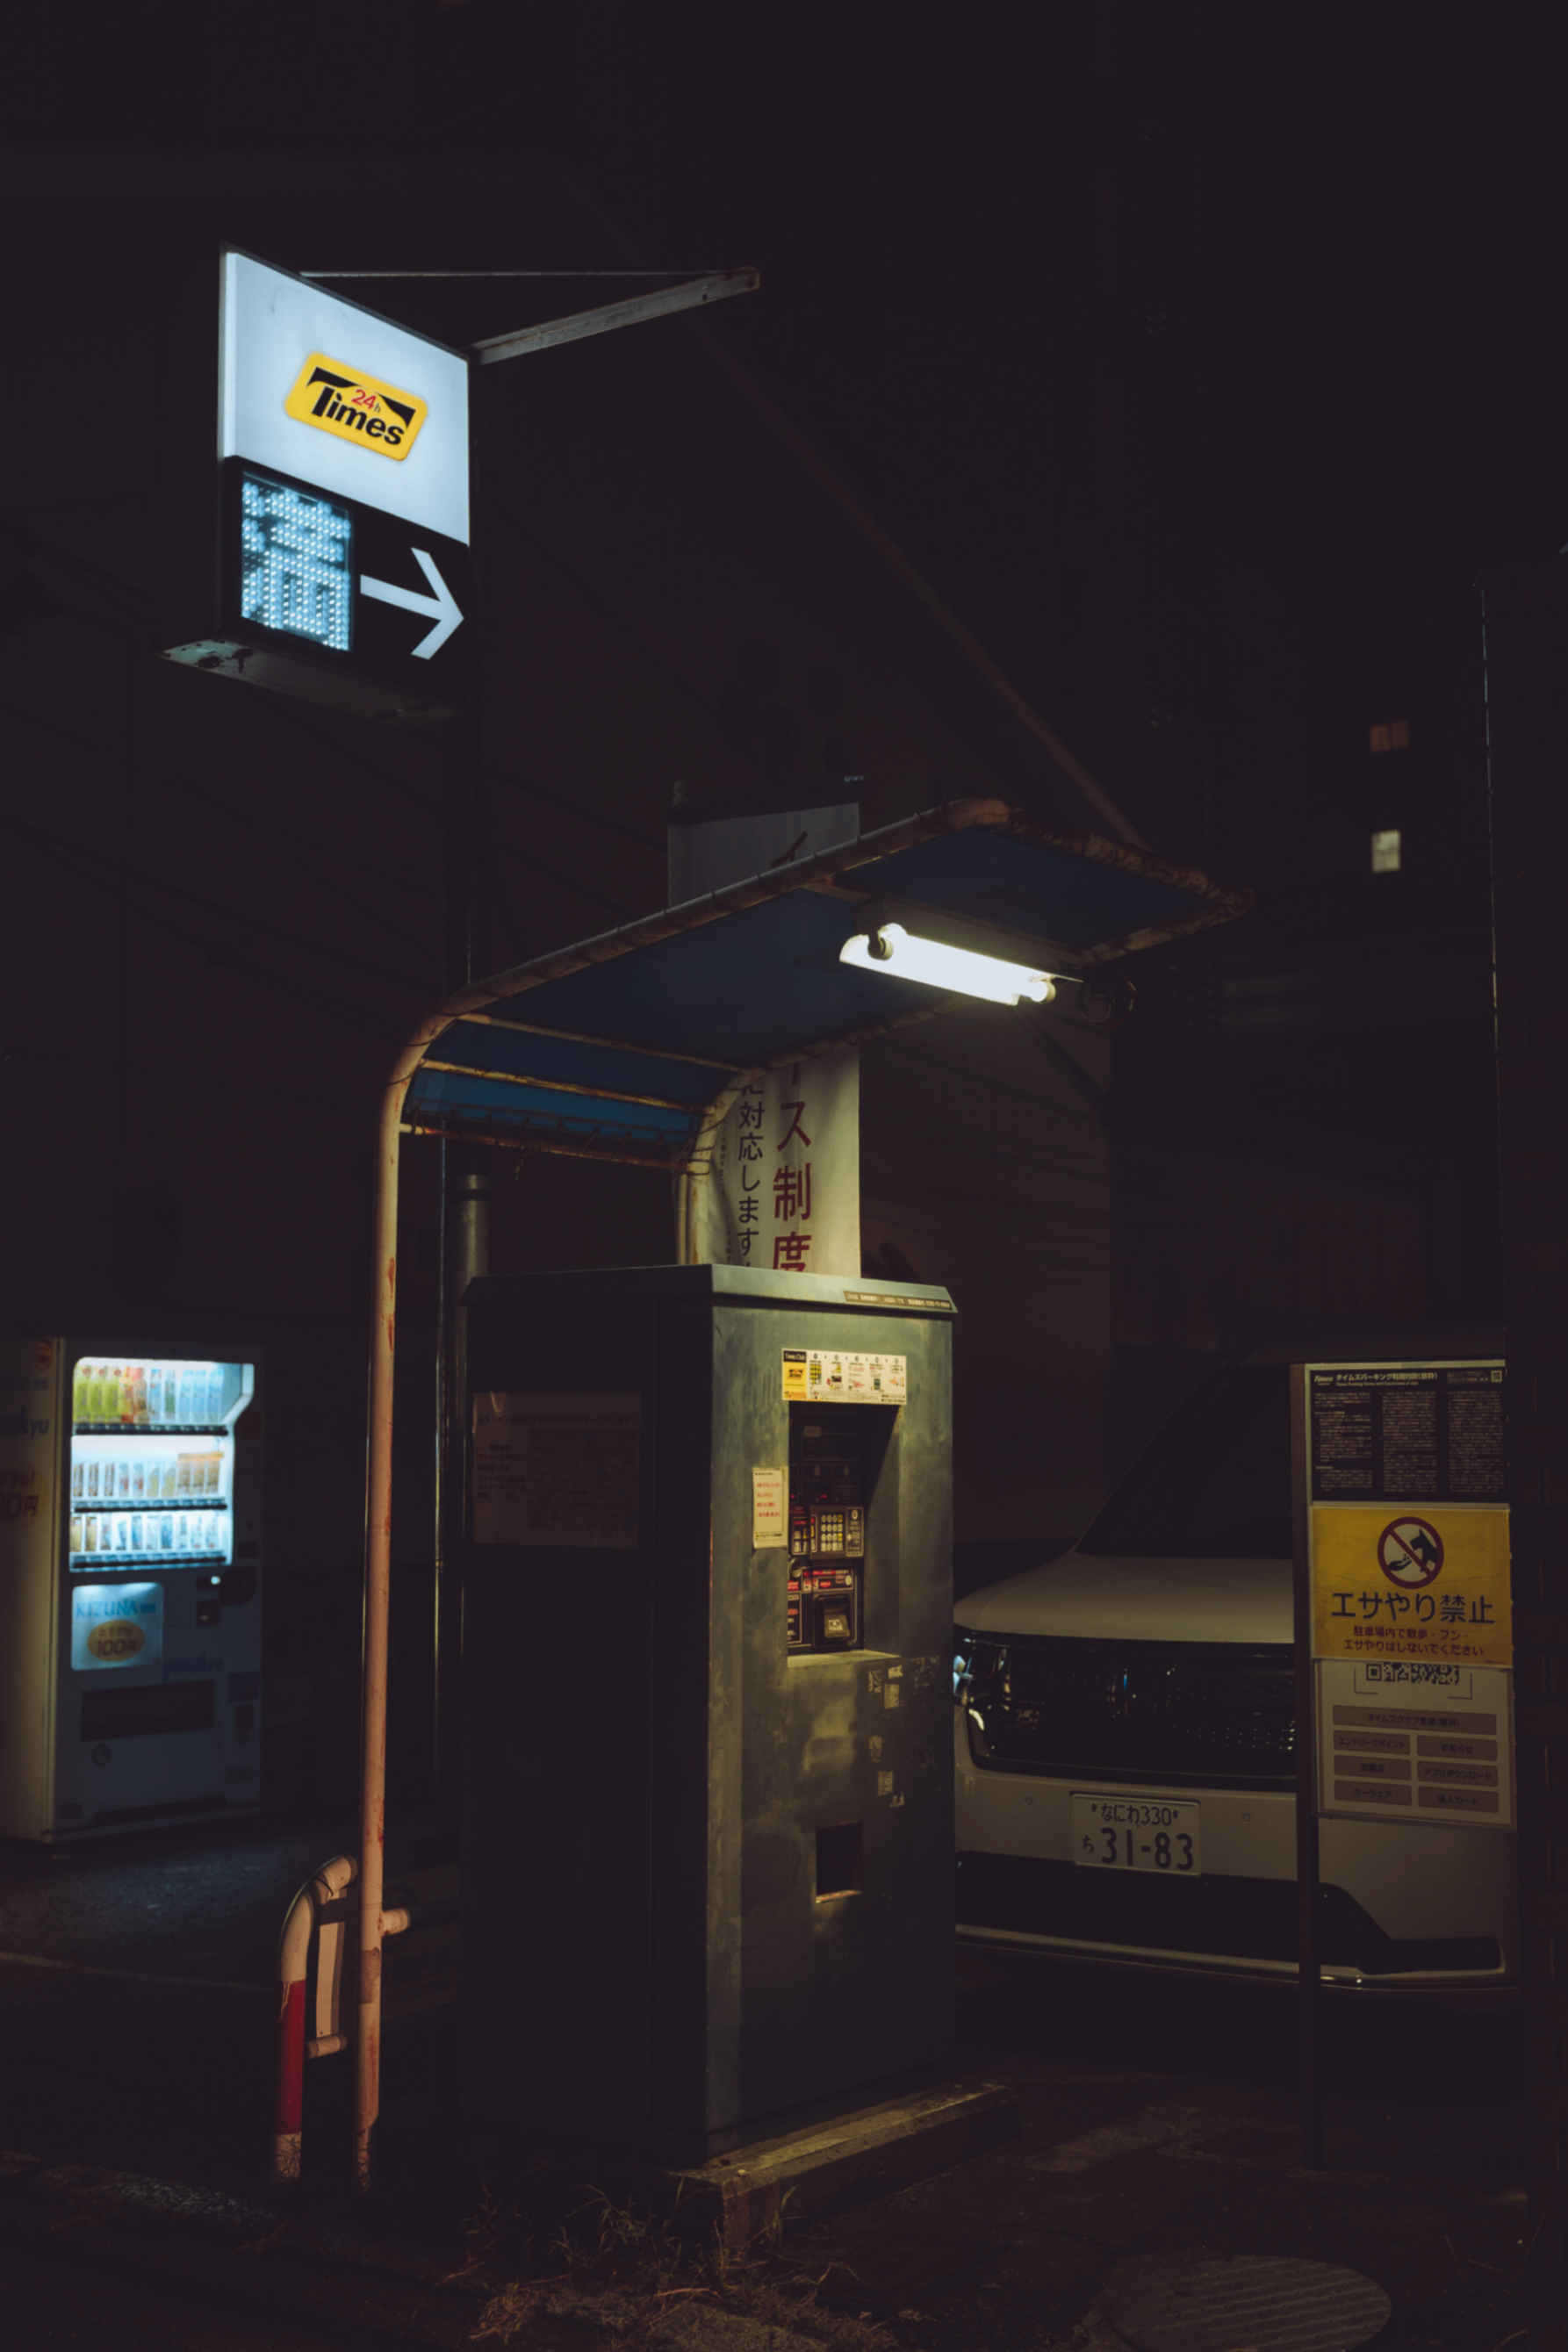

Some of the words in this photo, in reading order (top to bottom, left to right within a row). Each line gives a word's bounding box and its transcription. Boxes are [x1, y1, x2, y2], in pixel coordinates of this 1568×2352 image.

[306, 366, 416, 445] Times
[351, 389, 381, 414] 24h
[241, 483, 350, 651] 満
[737, 1084, 766, 1267] 対応します
[772, 1063, 812, 1272] ス制度
[1331, 1591, 1494, 1624] エサやり禁止
[1353, 1626, 1468, 1642] 駐車場内で散歩・フン・
[1343, 1639, 1484, 1656] エサやりはしないでください
[1339, 1737, 1405, 1750] エントリーでポイント
[1441, 1744, 1473, 1754] お知らせ
[1423, 1767, 1492, 1781] アプリダウンロード
[1353, 1787, 1392, 1799] カーシェア
[1082, 1835, 1094, 1853] ち
[1100, 1827, 1194, 1871] 31-83
